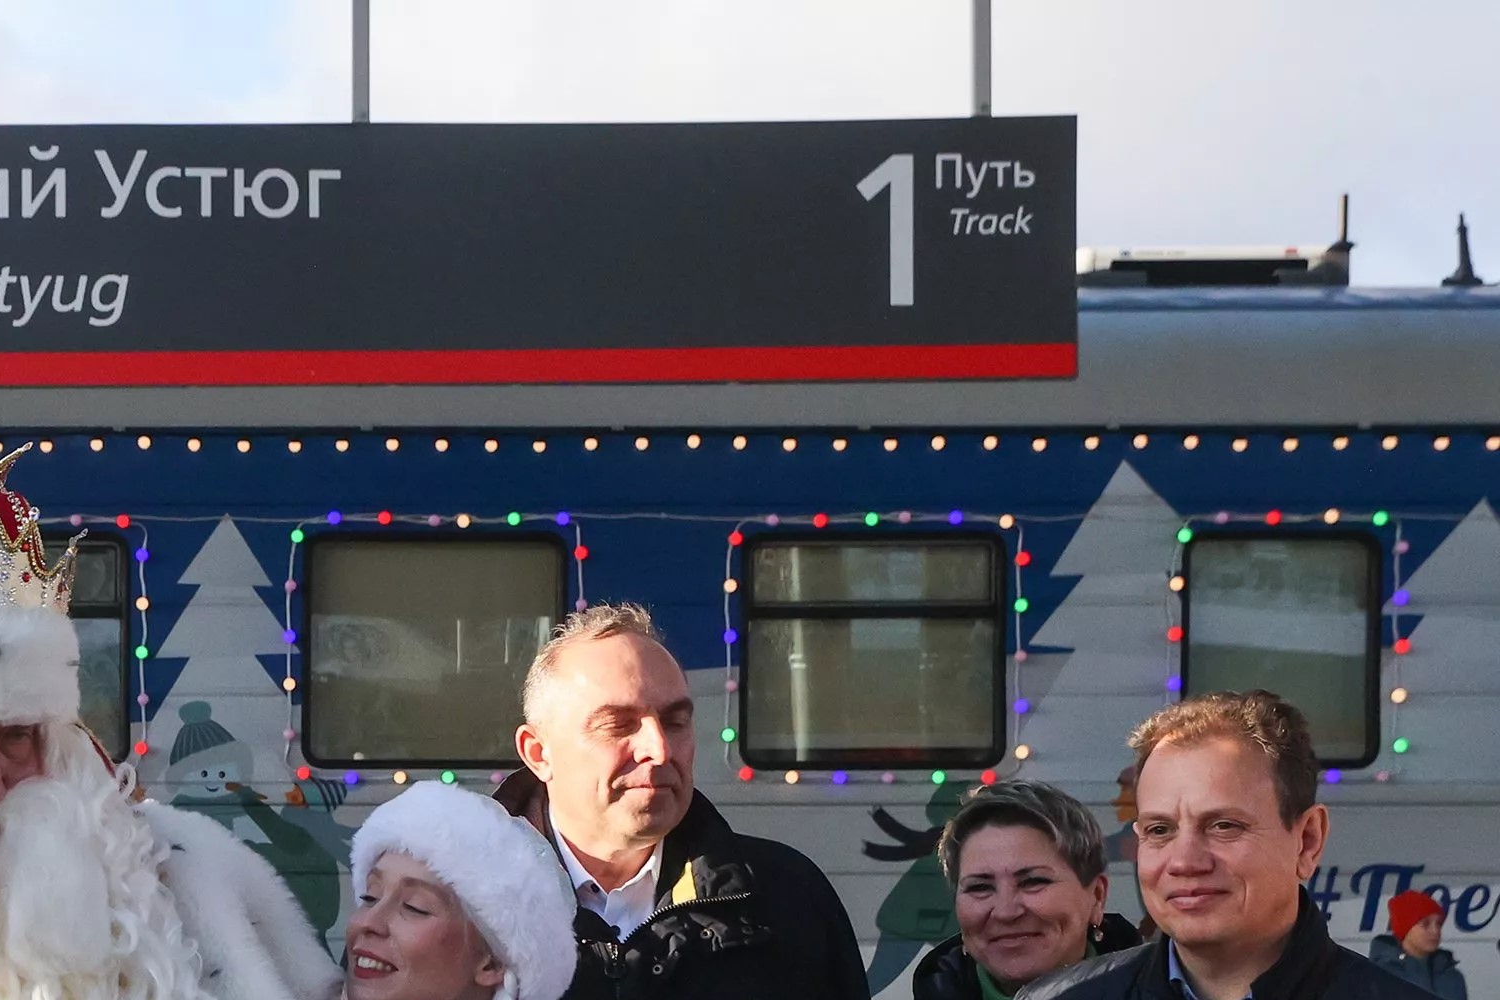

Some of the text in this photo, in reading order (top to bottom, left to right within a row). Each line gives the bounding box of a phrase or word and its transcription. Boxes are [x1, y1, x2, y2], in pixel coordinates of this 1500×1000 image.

[94, 150, 341, 218] Устюг
[936, 154, 1035, 198] Путь
[856, 154, 913, 306] 1
[951, 206, 1032, 235] Track
